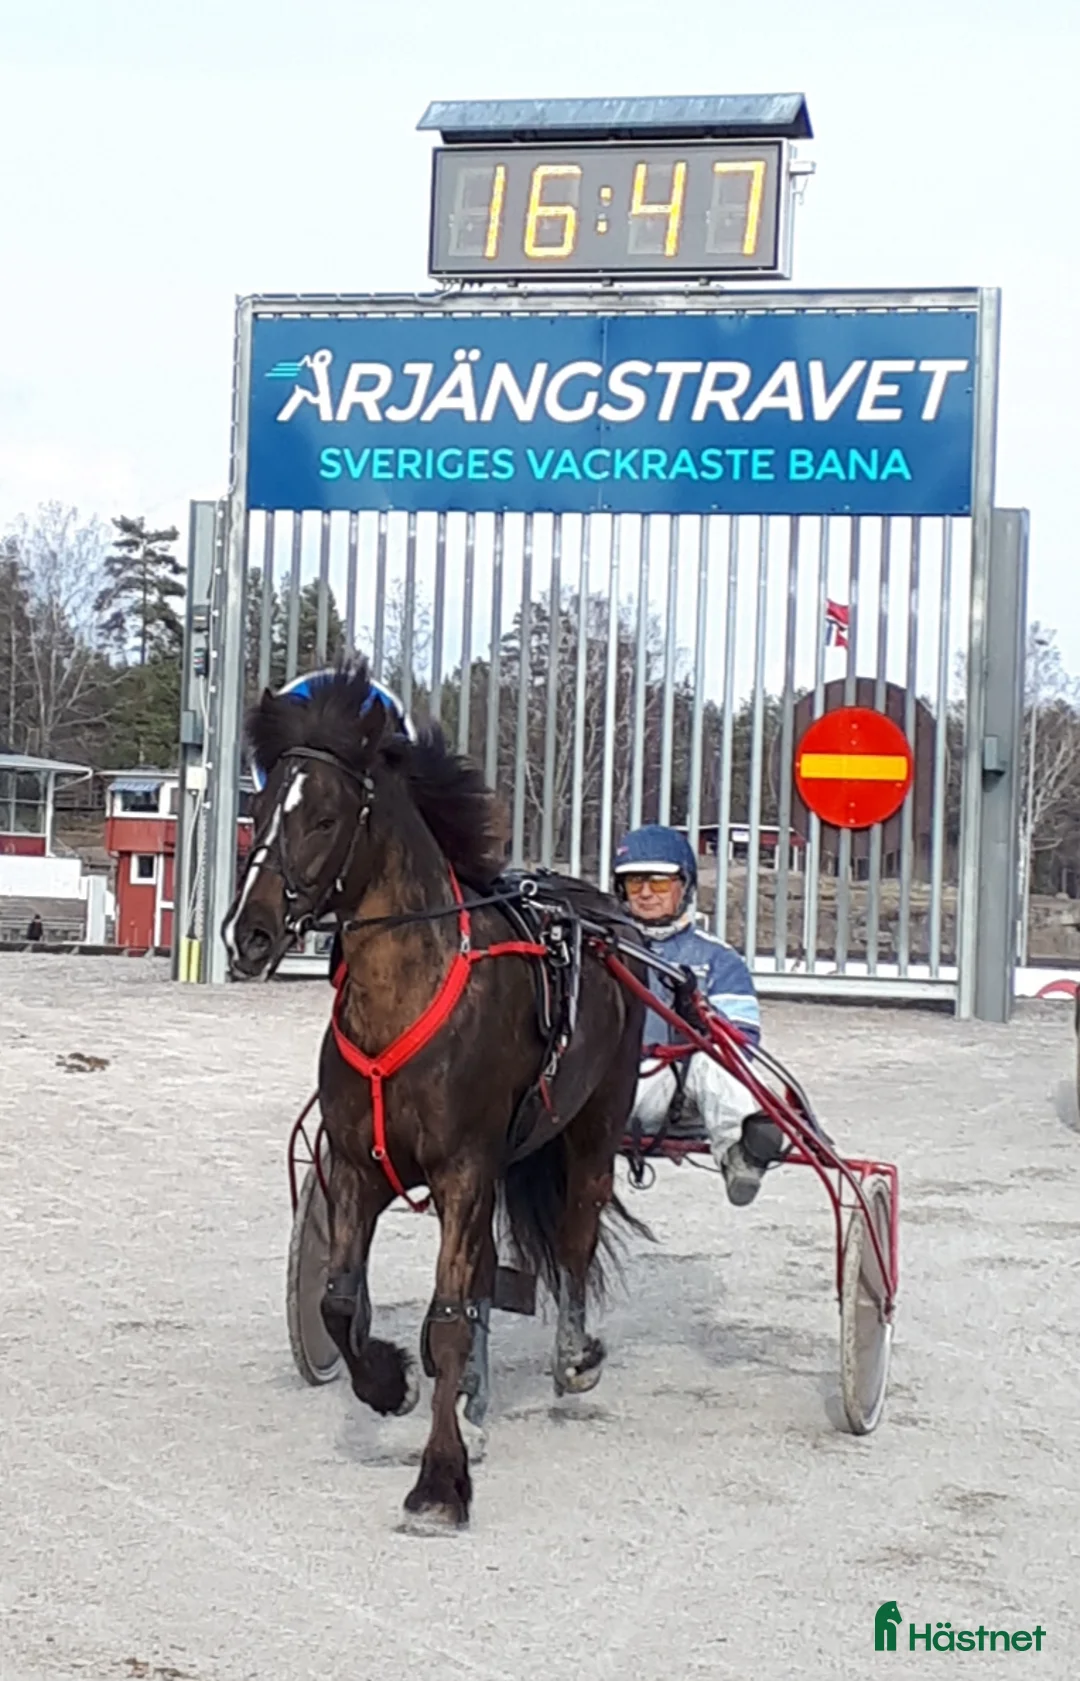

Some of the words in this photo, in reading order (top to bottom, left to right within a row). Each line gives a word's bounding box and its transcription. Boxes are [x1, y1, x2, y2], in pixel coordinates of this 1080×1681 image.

[484, 161, 767, 258] 16:47
[276, 348, 969, 423] ÅRJÄNGSTRAVET
[319, 447, 515, 480] SVERIGES
[526, 447, 775, 481] VACKRASTE
[788, 447, 912, 481] BANA
